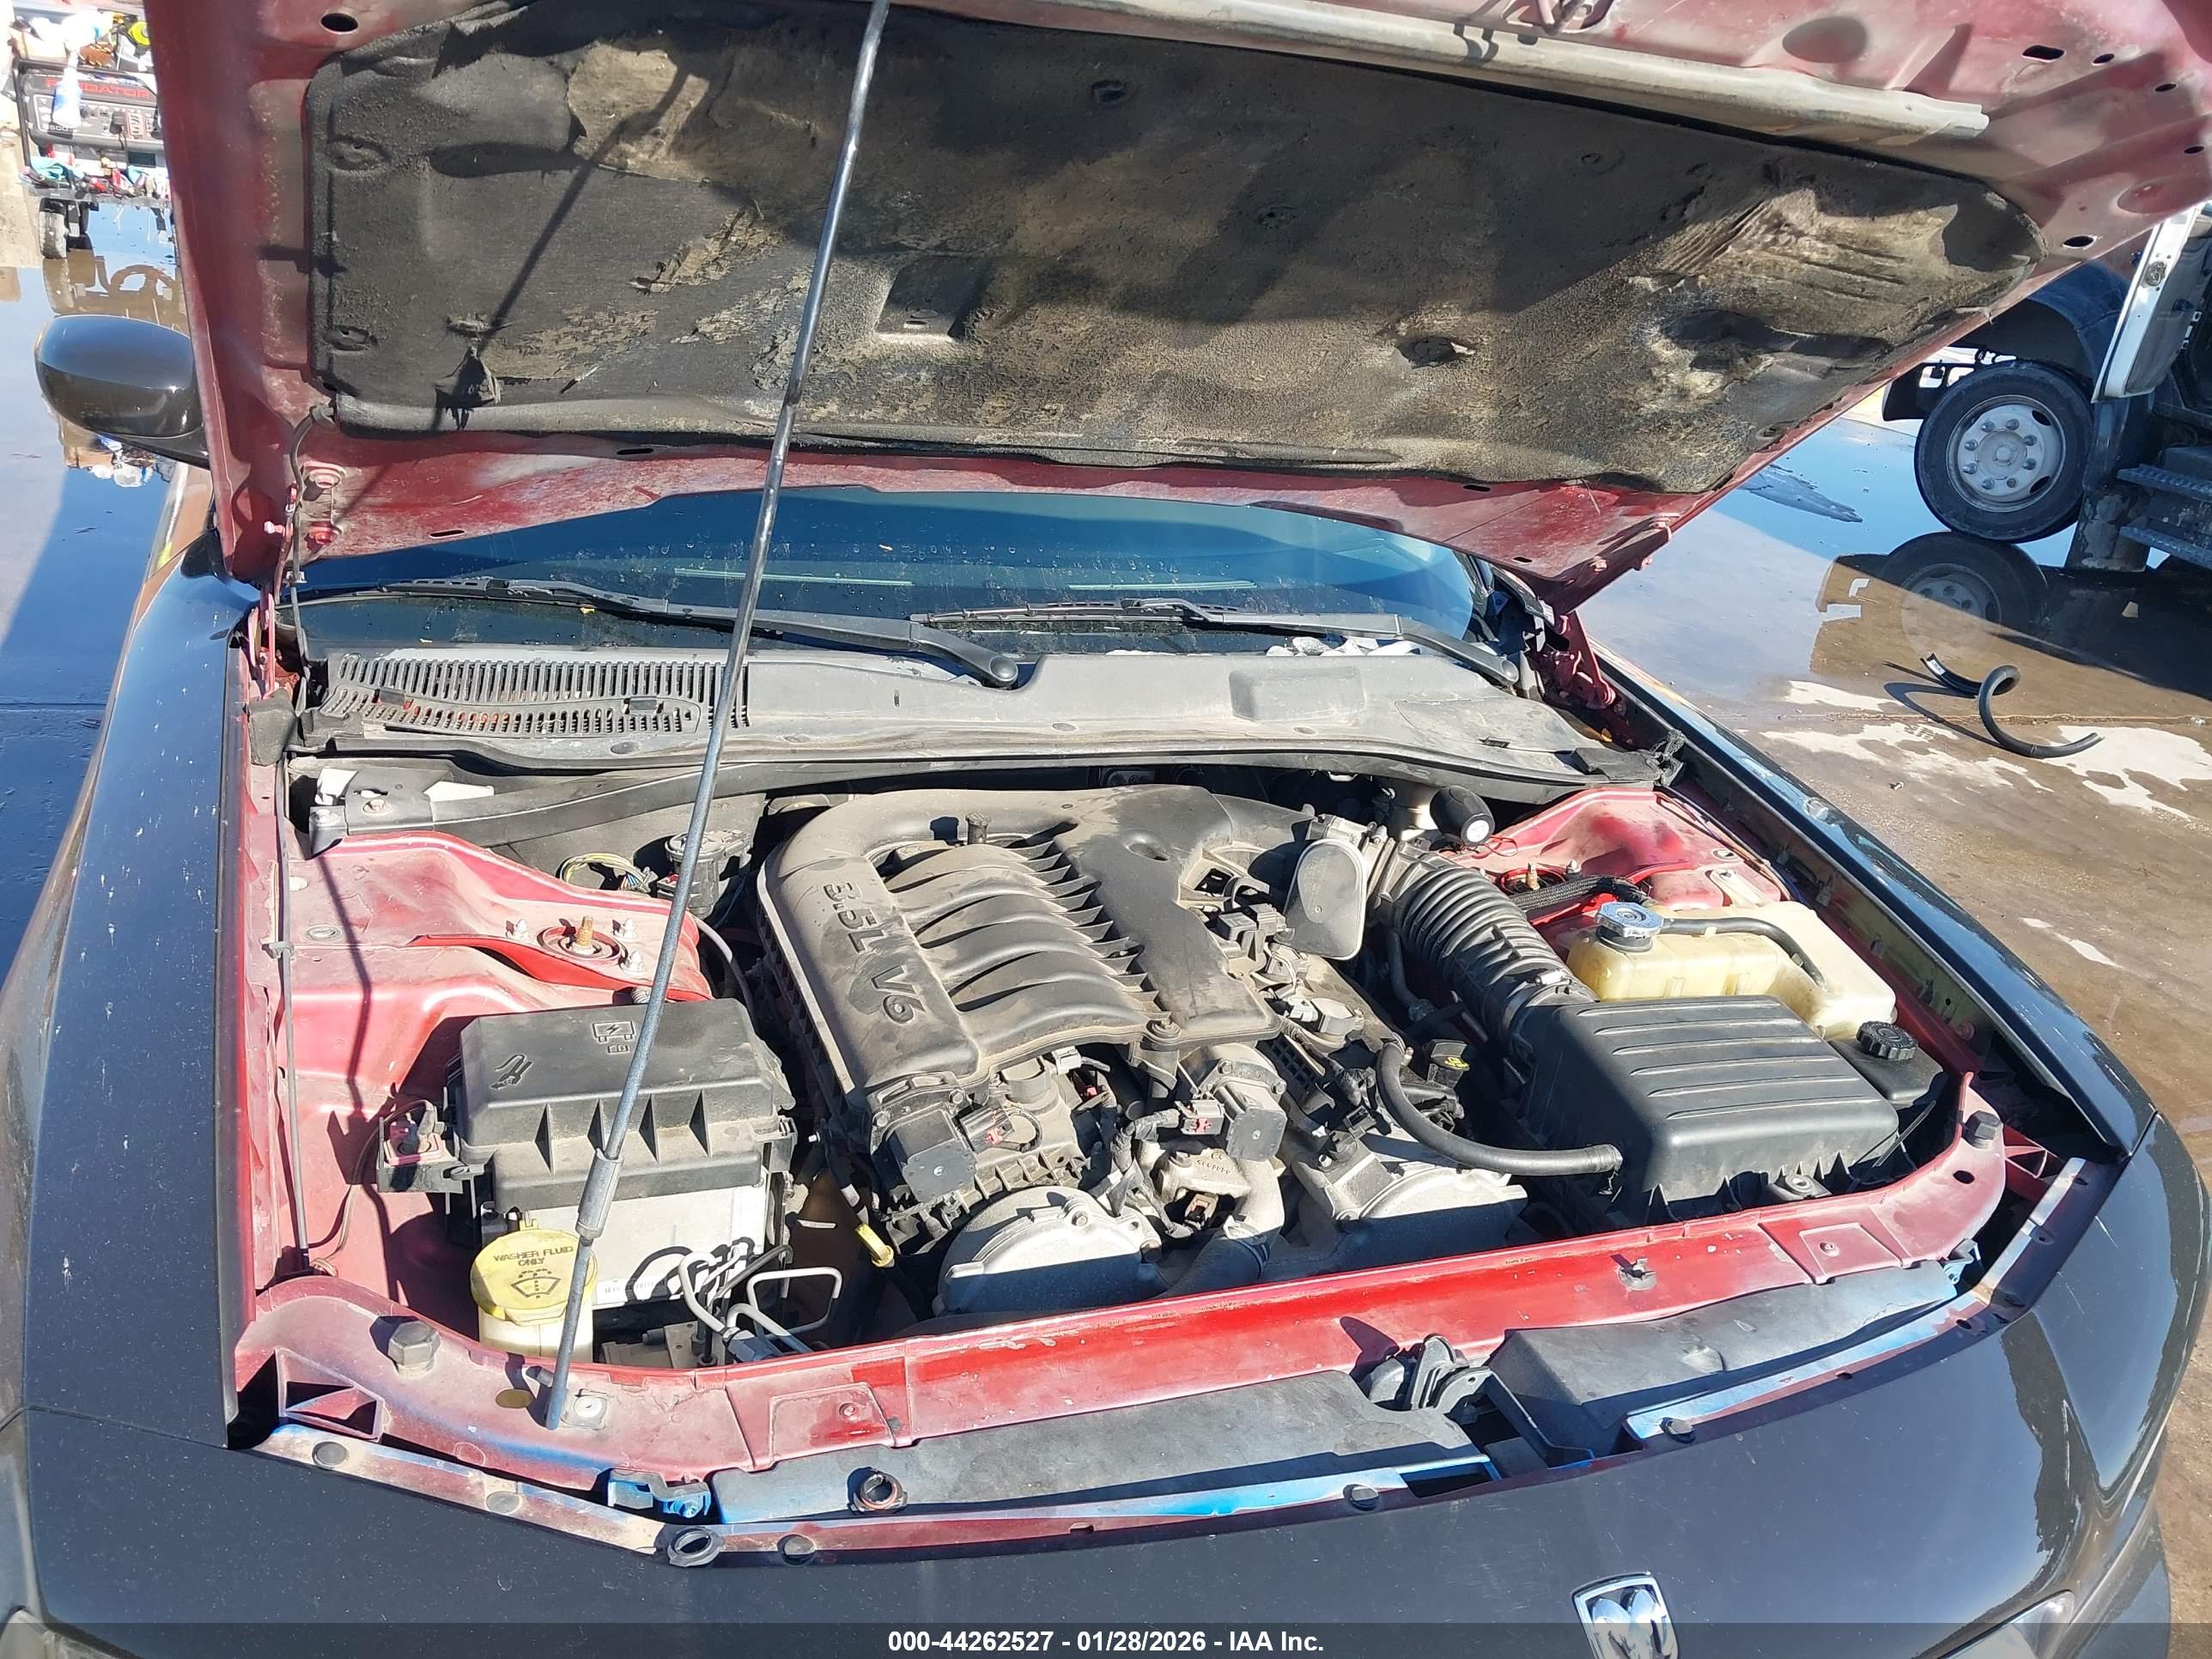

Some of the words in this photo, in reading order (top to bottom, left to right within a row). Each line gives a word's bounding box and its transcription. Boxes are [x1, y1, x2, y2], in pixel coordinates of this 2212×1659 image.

[824, 882, 886, 953] 3.5L
[871, 964, 927, 1024] V6
[493, 1250, 539, 1261] WASHER
[543, 1246, 574, 1256] FLUID
[518, 1257, 545, 1267] ONLY
